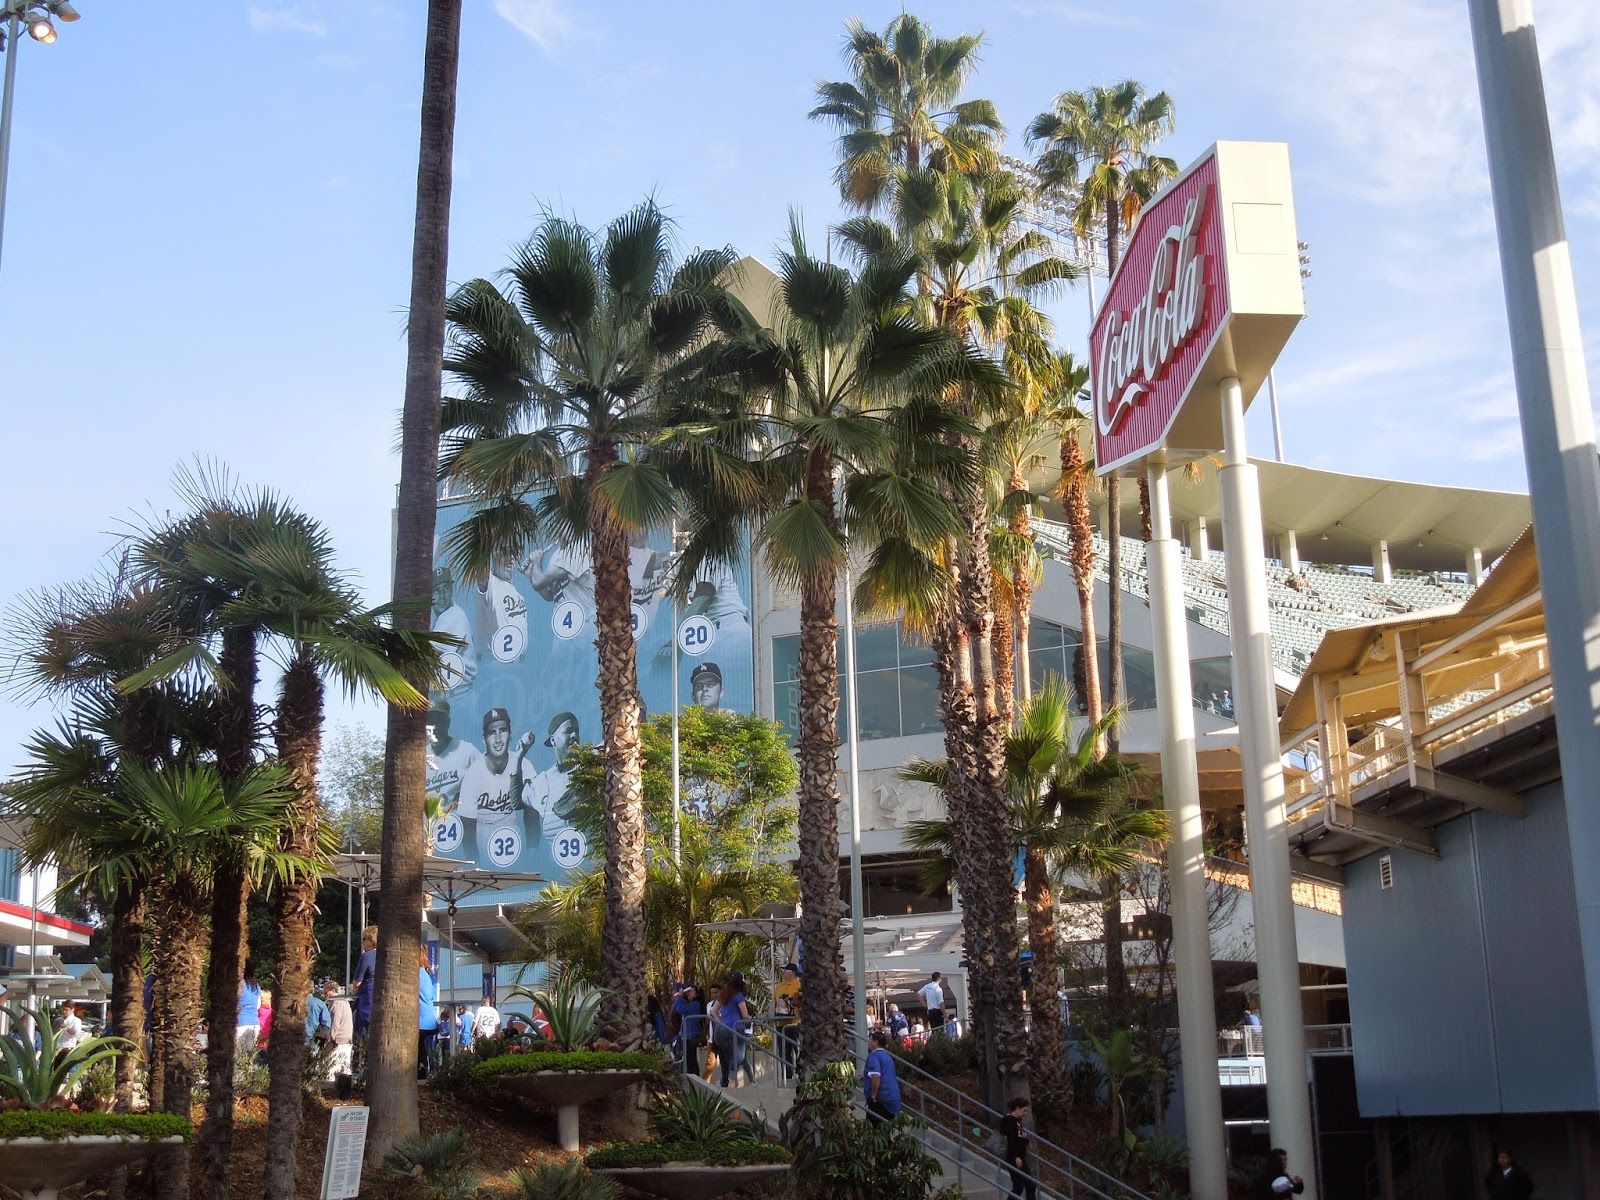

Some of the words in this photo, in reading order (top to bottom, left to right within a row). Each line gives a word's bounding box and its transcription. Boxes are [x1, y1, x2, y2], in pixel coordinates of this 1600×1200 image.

[562, 610, 573, 629] 4
[503, 633, 513, 653] 2
[685, 625, 708, 646] 20
[446, 662, 451, 680] 1
[437, 822, 458, 843] 24
[494, 837, 515, 857] 32
[559, 837, 581, 858] 39
[482, 1015, 495, 1027] 22
